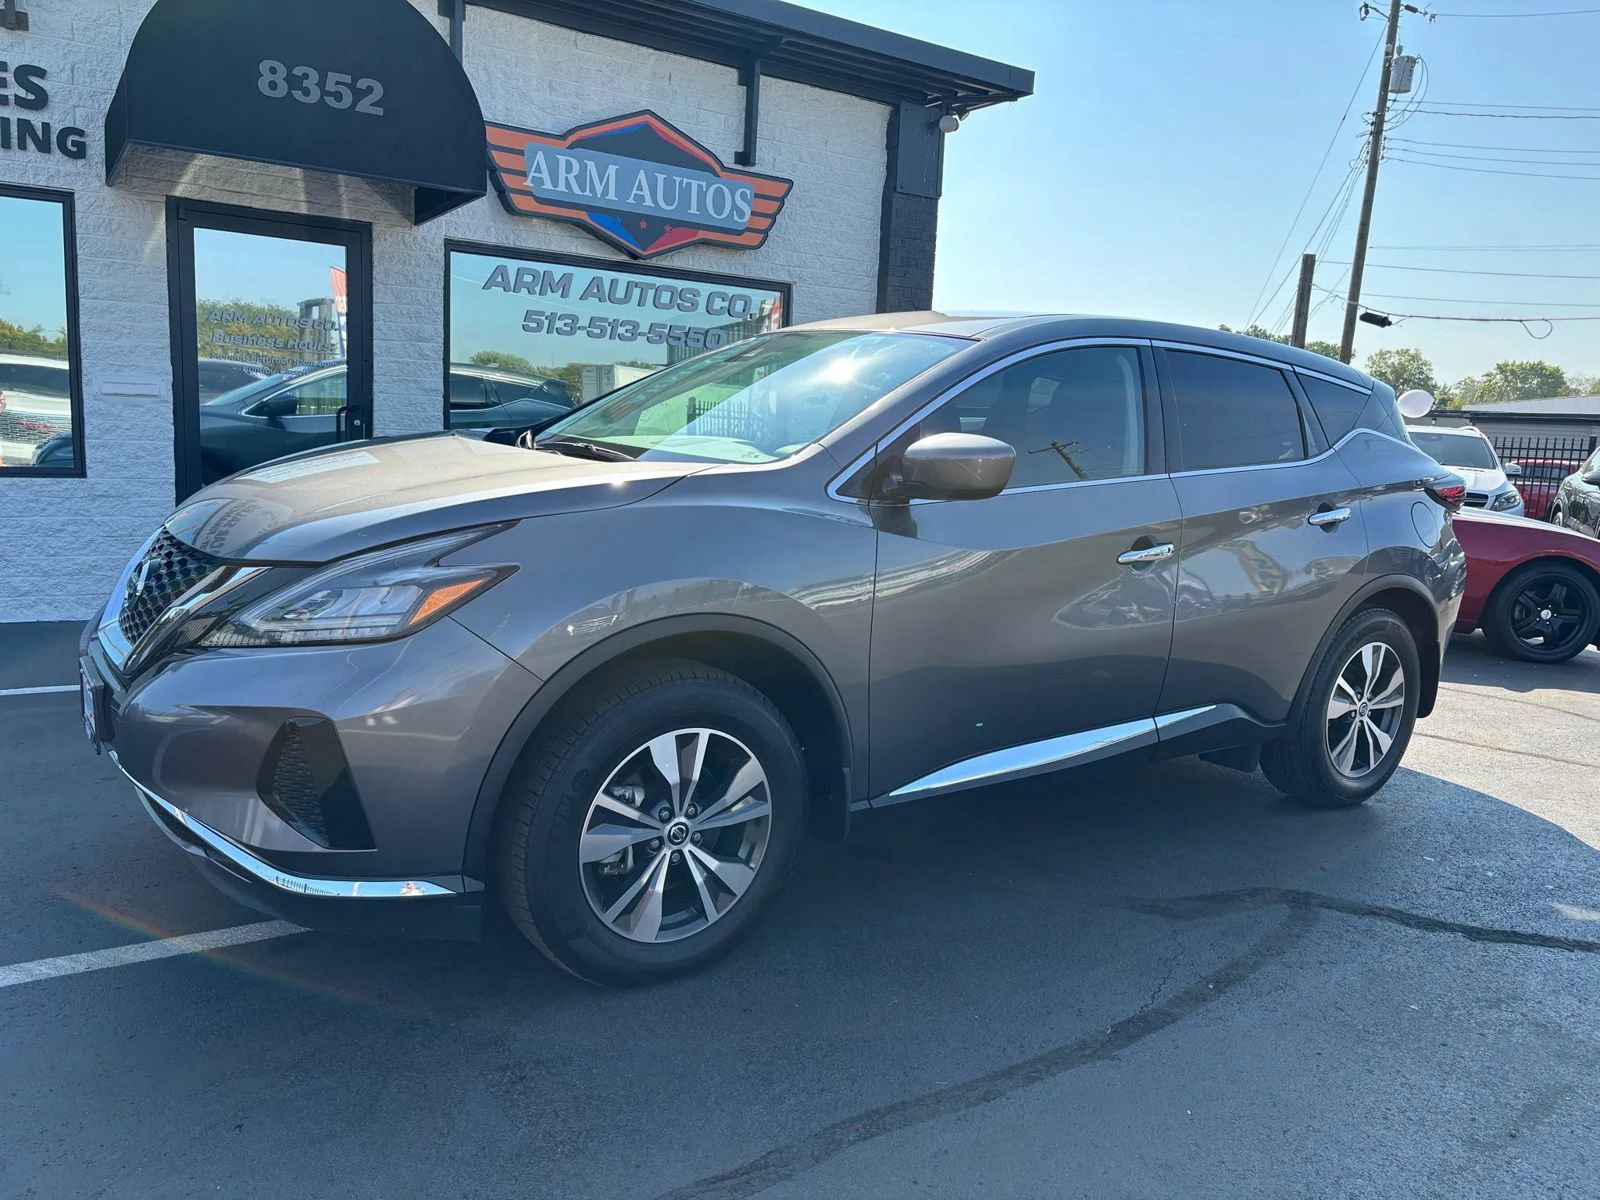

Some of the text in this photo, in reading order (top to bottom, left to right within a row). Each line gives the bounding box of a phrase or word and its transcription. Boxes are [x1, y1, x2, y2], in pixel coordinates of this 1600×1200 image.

[258, 60, 384, 116] 8352
[523, 150, 753, 223] ARM AUTOS
[482, 264, 757, 319] ARM AUTOS CO.
[208, 310, 248, 323] ARM
[251, 314, 308, 329] AUTOS
[522, 309, 727, 350] 513-513-5550
